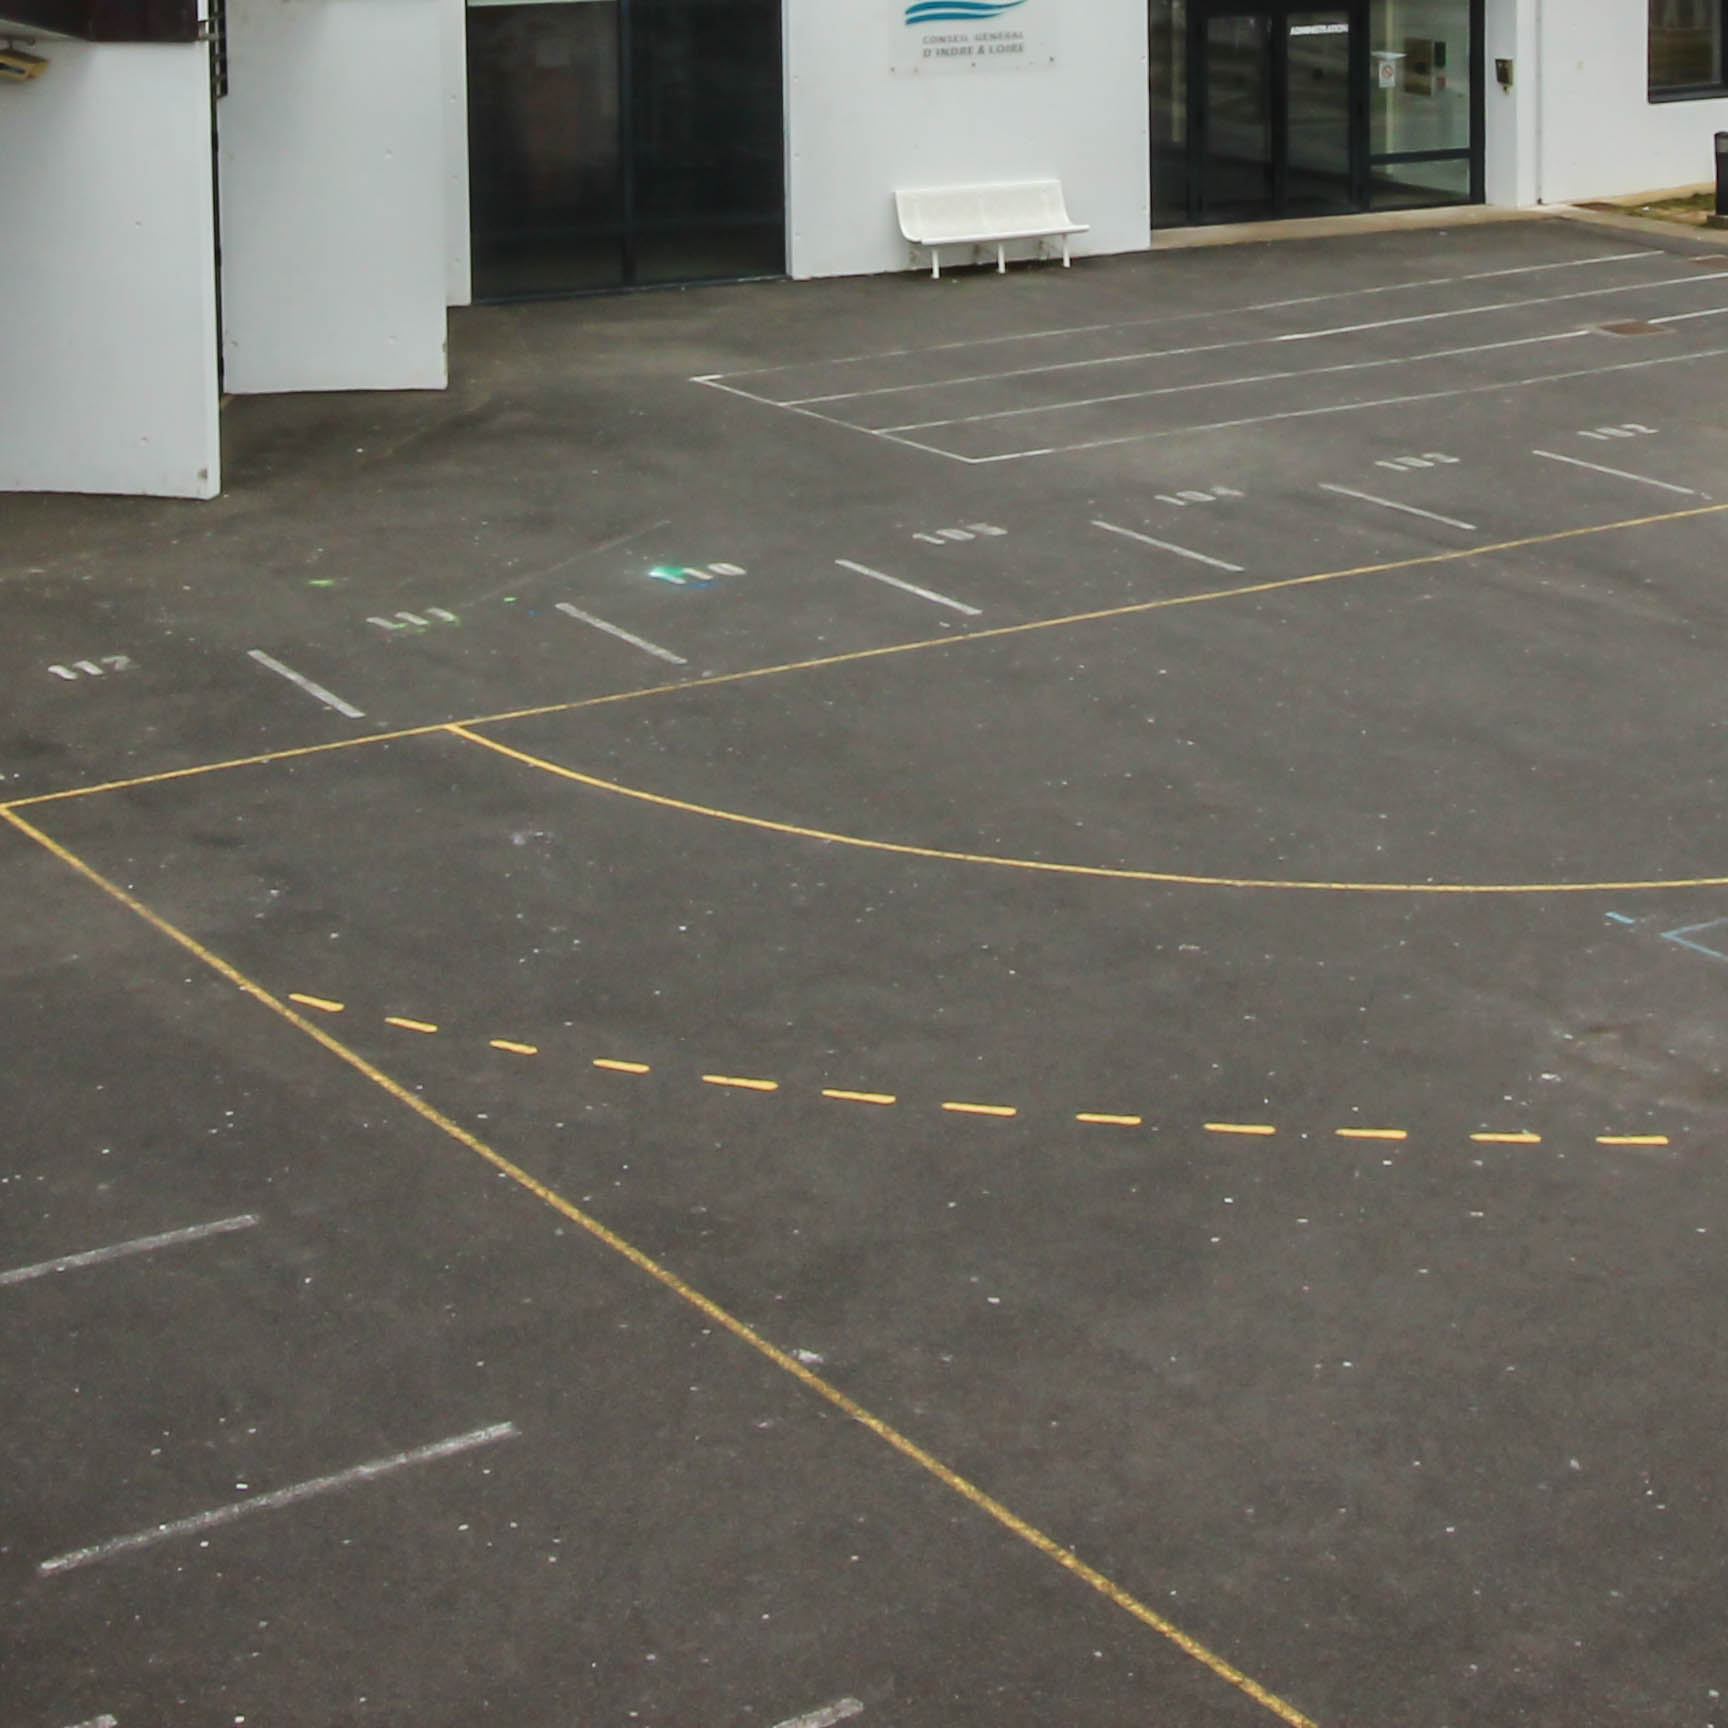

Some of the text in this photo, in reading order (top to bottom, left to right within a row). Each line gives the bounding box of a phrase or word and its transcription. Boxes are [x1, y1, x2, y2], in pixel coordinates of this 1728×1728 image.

[988, 43, 1024, 54] LOIRE
[1577, 423, 1660, 441] 102
[648, 562, 747, 585] 110
